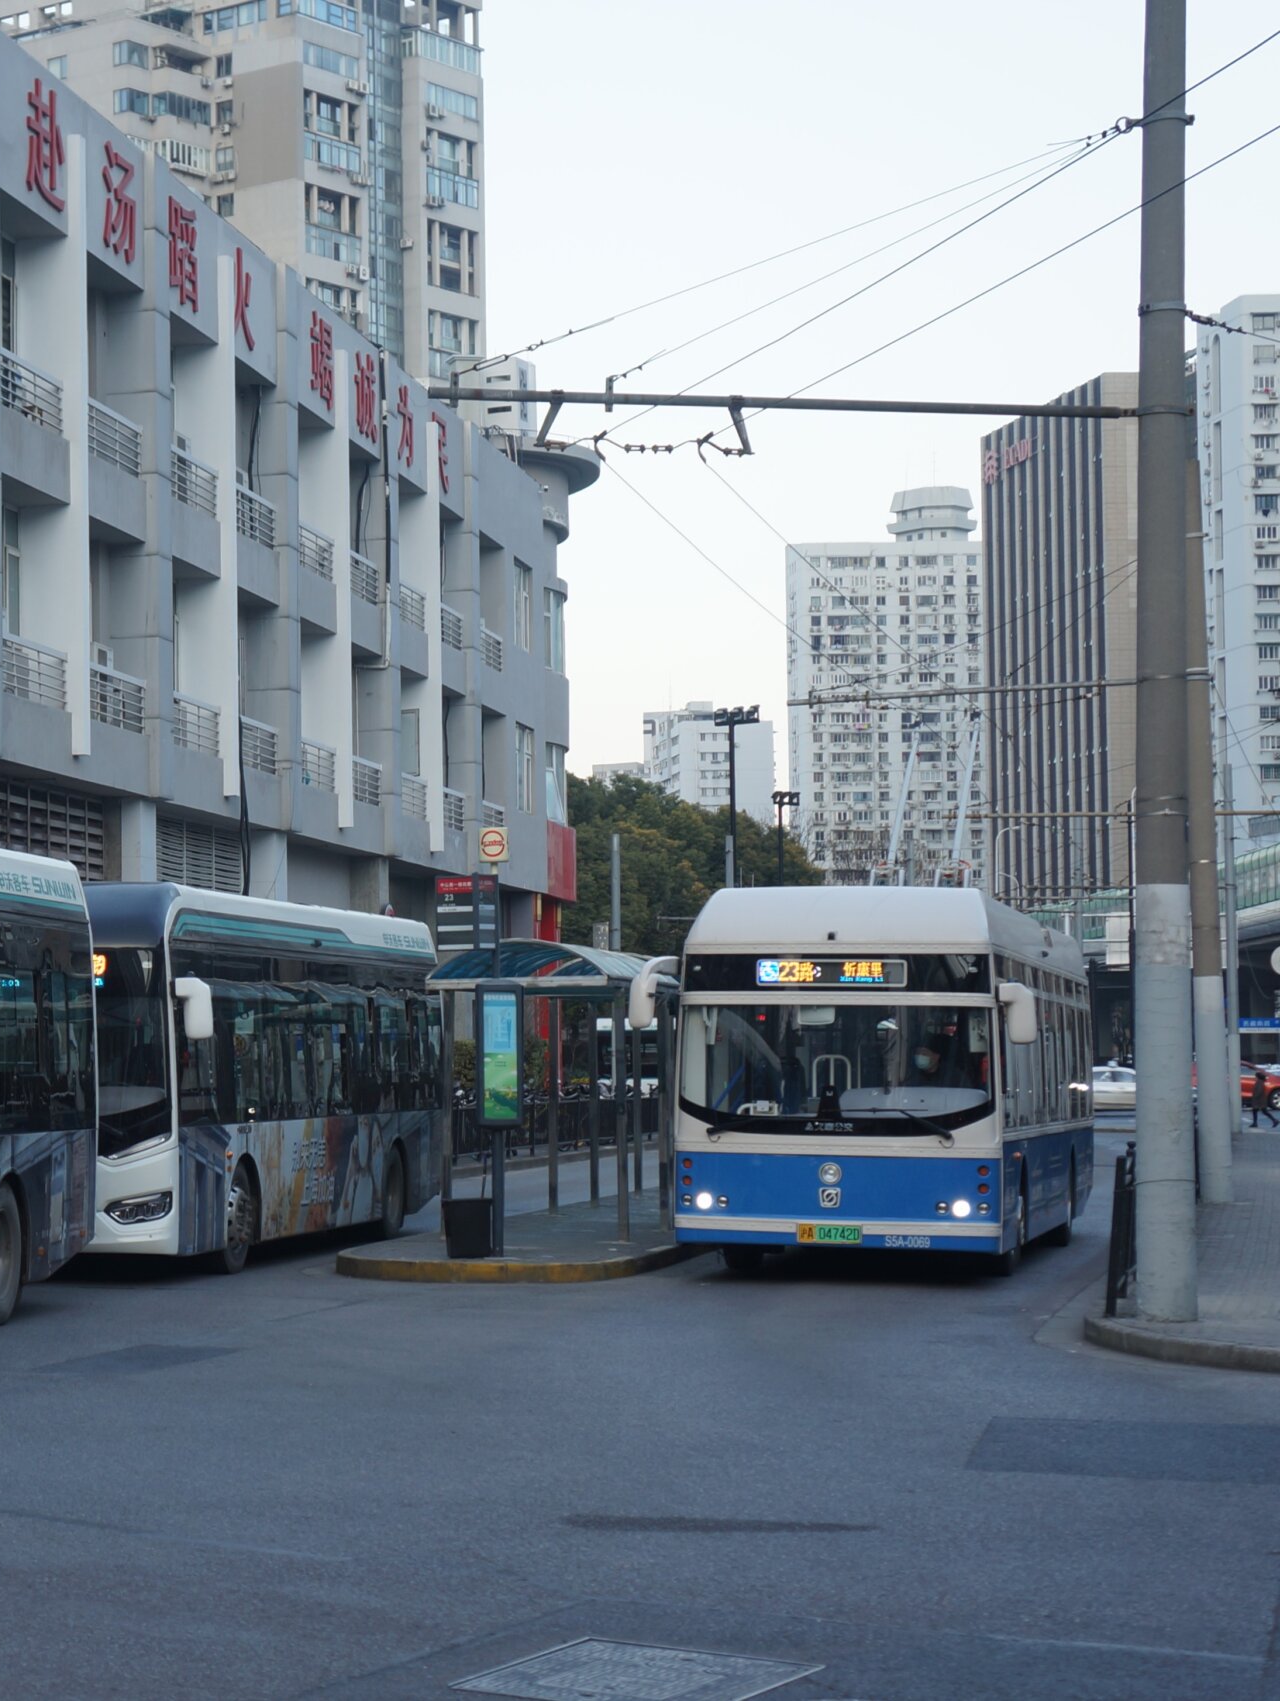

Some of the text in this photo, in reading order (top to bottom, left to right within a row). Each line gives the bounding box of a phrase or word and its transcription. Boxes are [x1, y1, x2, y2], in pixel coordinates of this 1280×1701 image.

[31, 876, 77, 900] SUNWIN
[444, 894, 454, 902] 23
[779, 961, 815, 982] 23路
[818, 1227, 860, 1241] 04742D
[885, 1235, 931, 1249] S5A-0069
